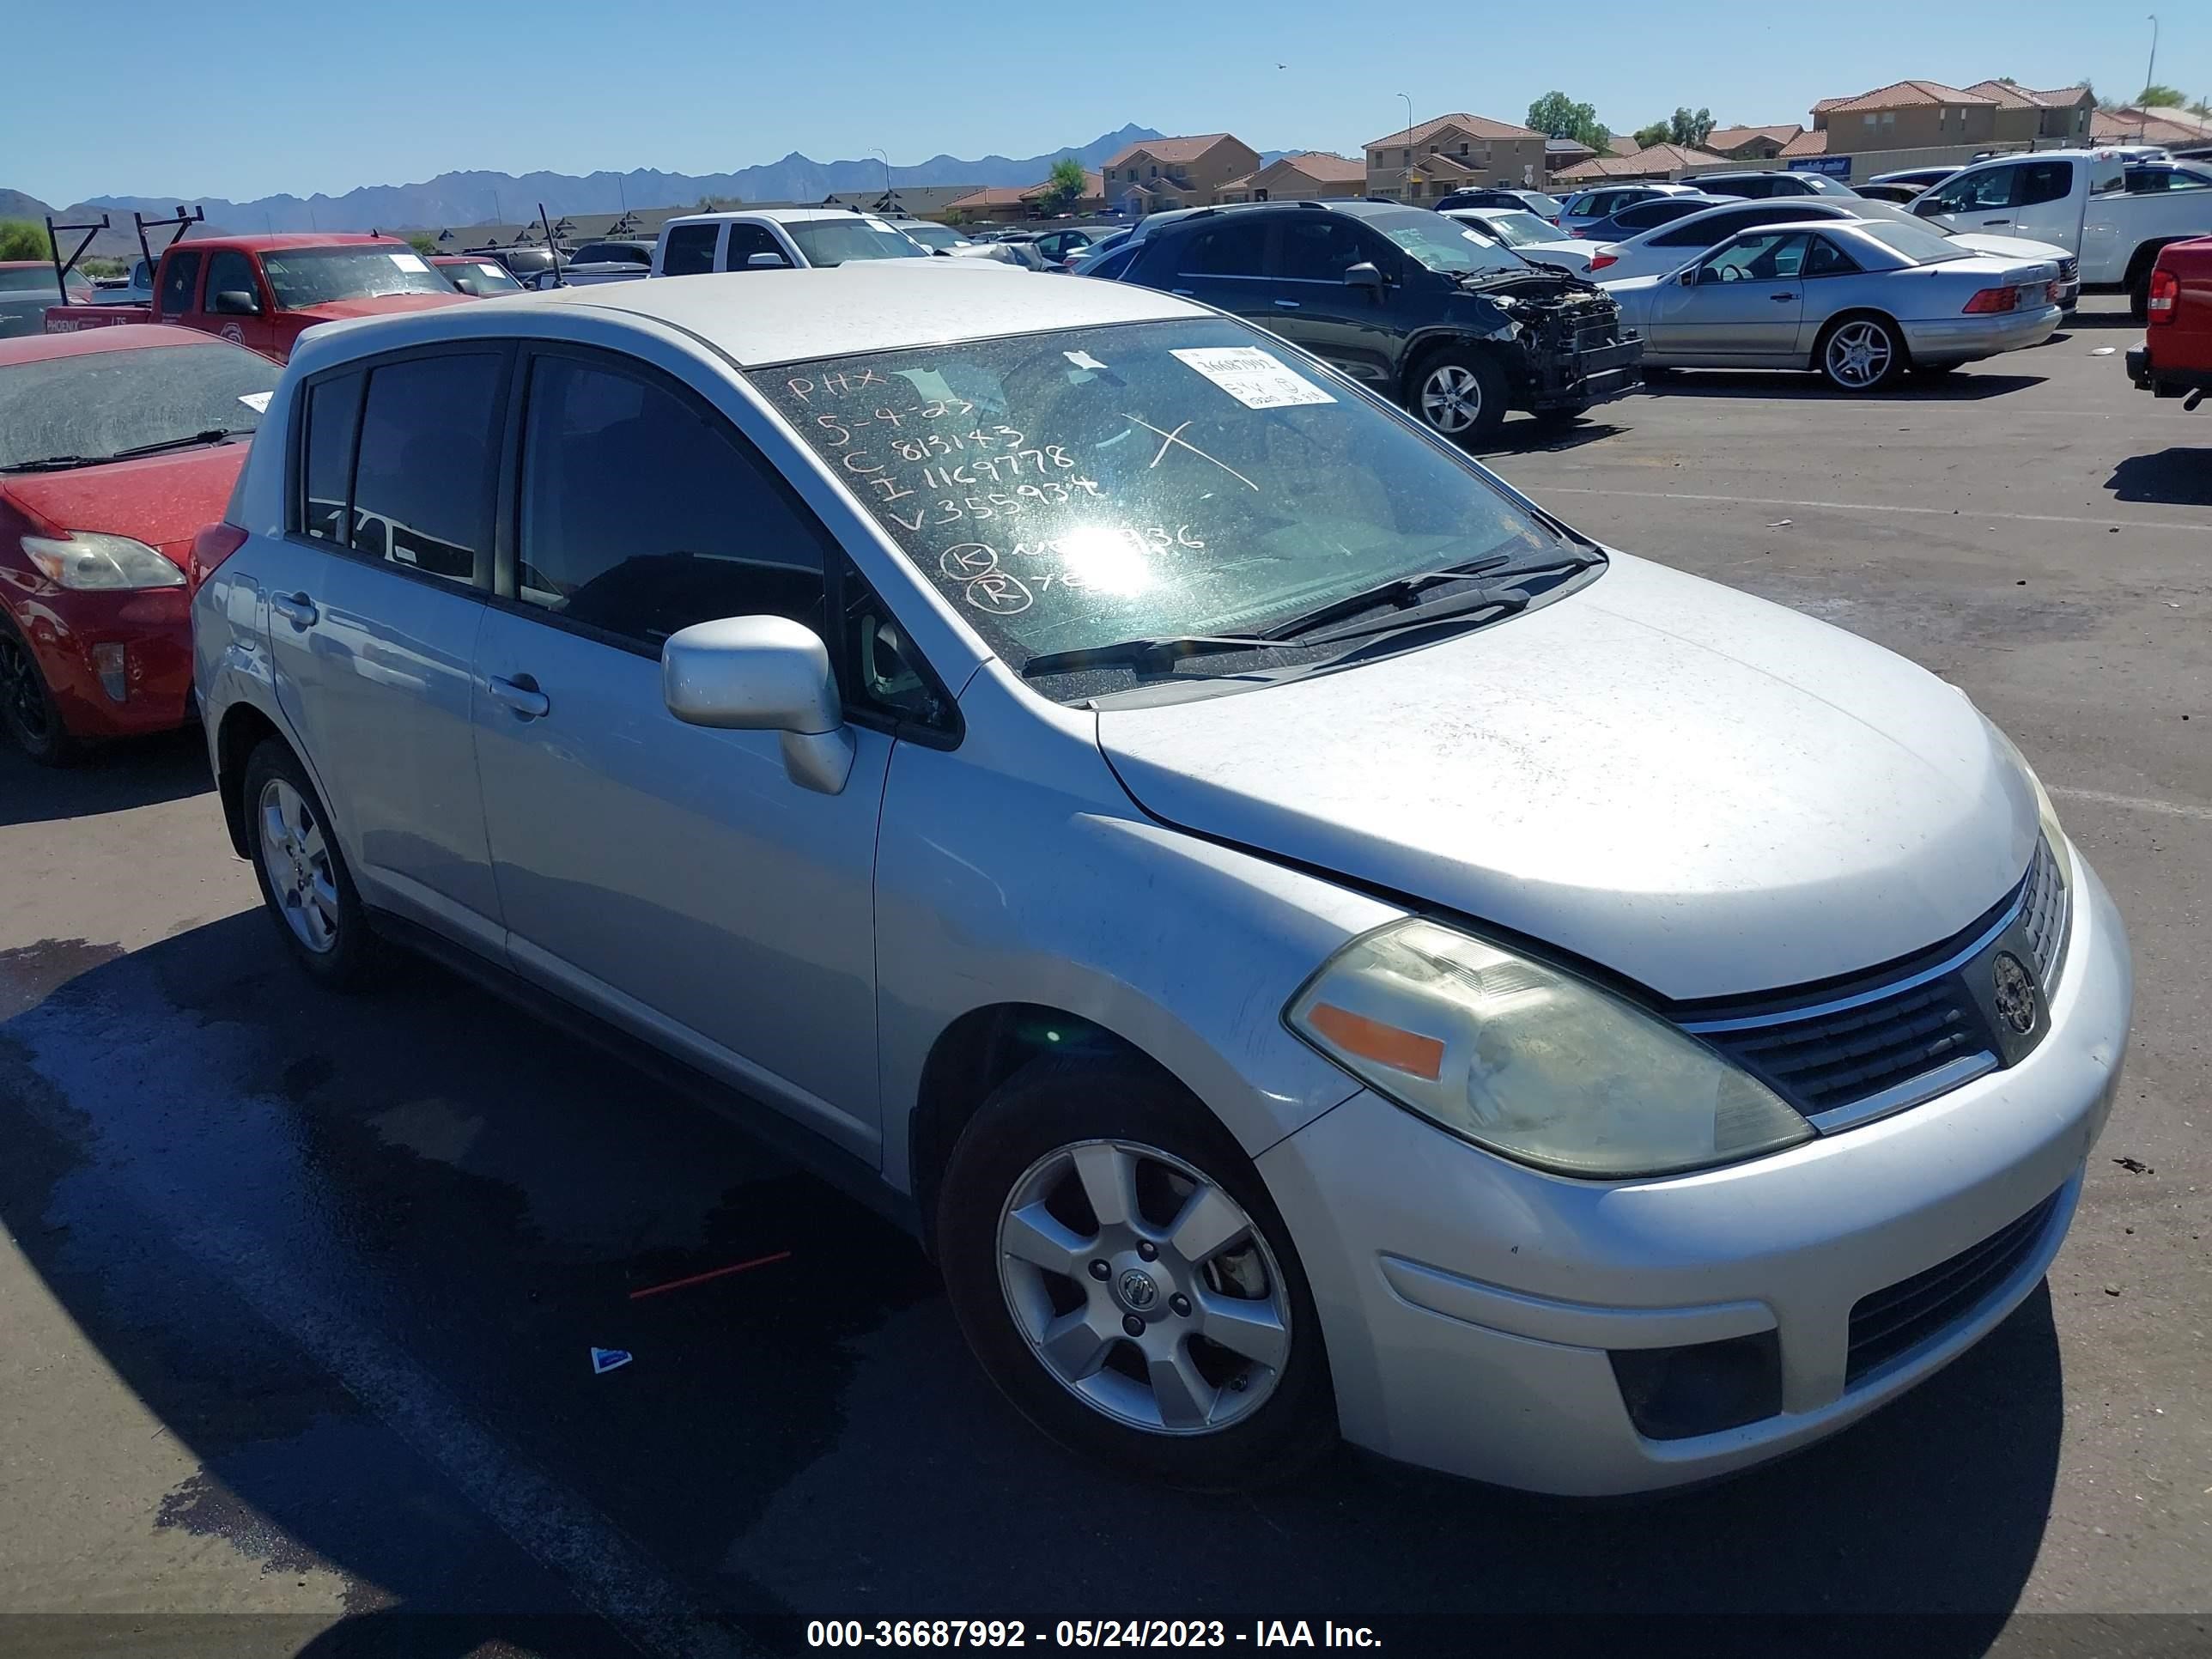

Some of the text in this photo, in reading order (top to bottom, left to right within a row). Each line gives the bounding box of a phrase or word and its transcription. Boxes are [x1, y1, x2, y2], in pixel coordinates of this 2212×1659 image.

[47, 319, 79, 332] PHOENIX
[1197, 358, 1276, 373] 36687992
[787, 369, 887, 404] PHX
[817, 399, 974, 446] 5-4-23
[843, 425, 1024, 473] C 813143
[924, 446, 1074, 489] 1169778
[889, 509, 925, 531] V
[977, 580, 1023, 605] R
